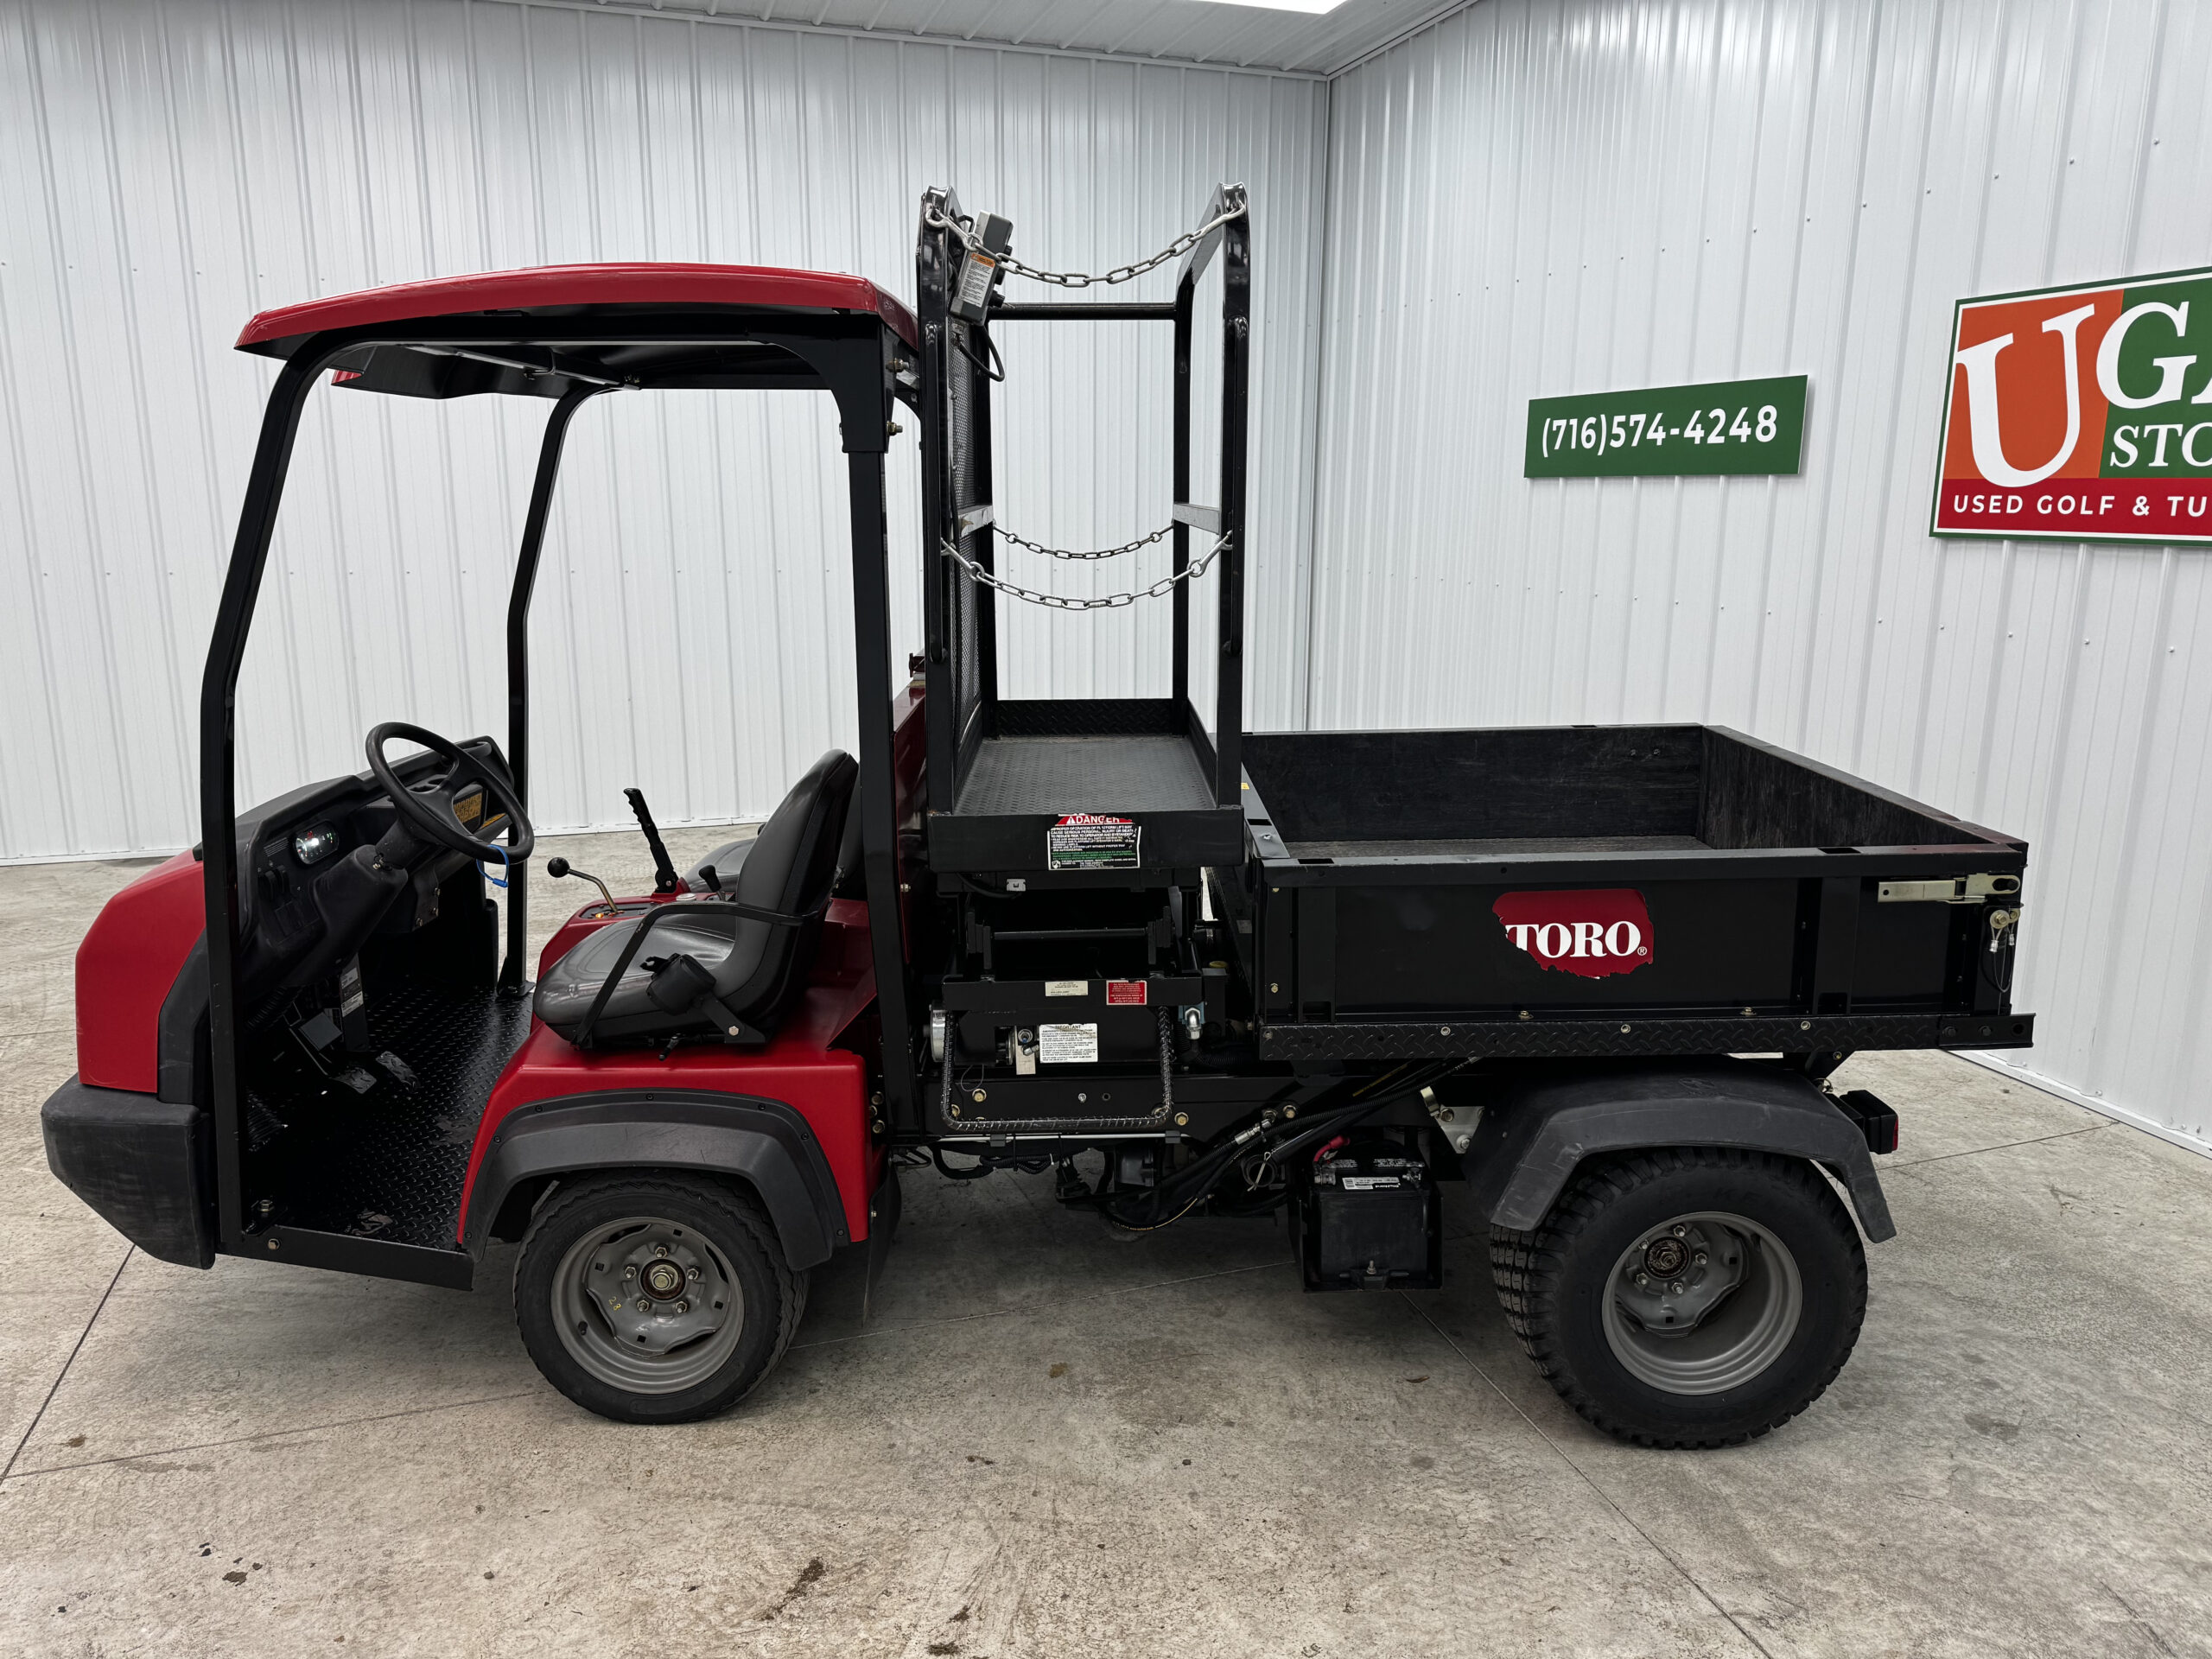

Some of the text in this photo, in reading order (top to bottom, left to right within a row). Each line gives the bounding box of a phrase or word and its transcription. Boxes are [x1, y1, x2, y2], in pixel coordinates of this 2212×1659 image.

[1542, 404, 1777, 457] (716)574-4248
[1954, 495, 2023, 513] USED
[2037, 495, 2115, 515] GOLF
[2132, 495, 2150, 516] &
[1505, 920, 1641, 958] TORO
